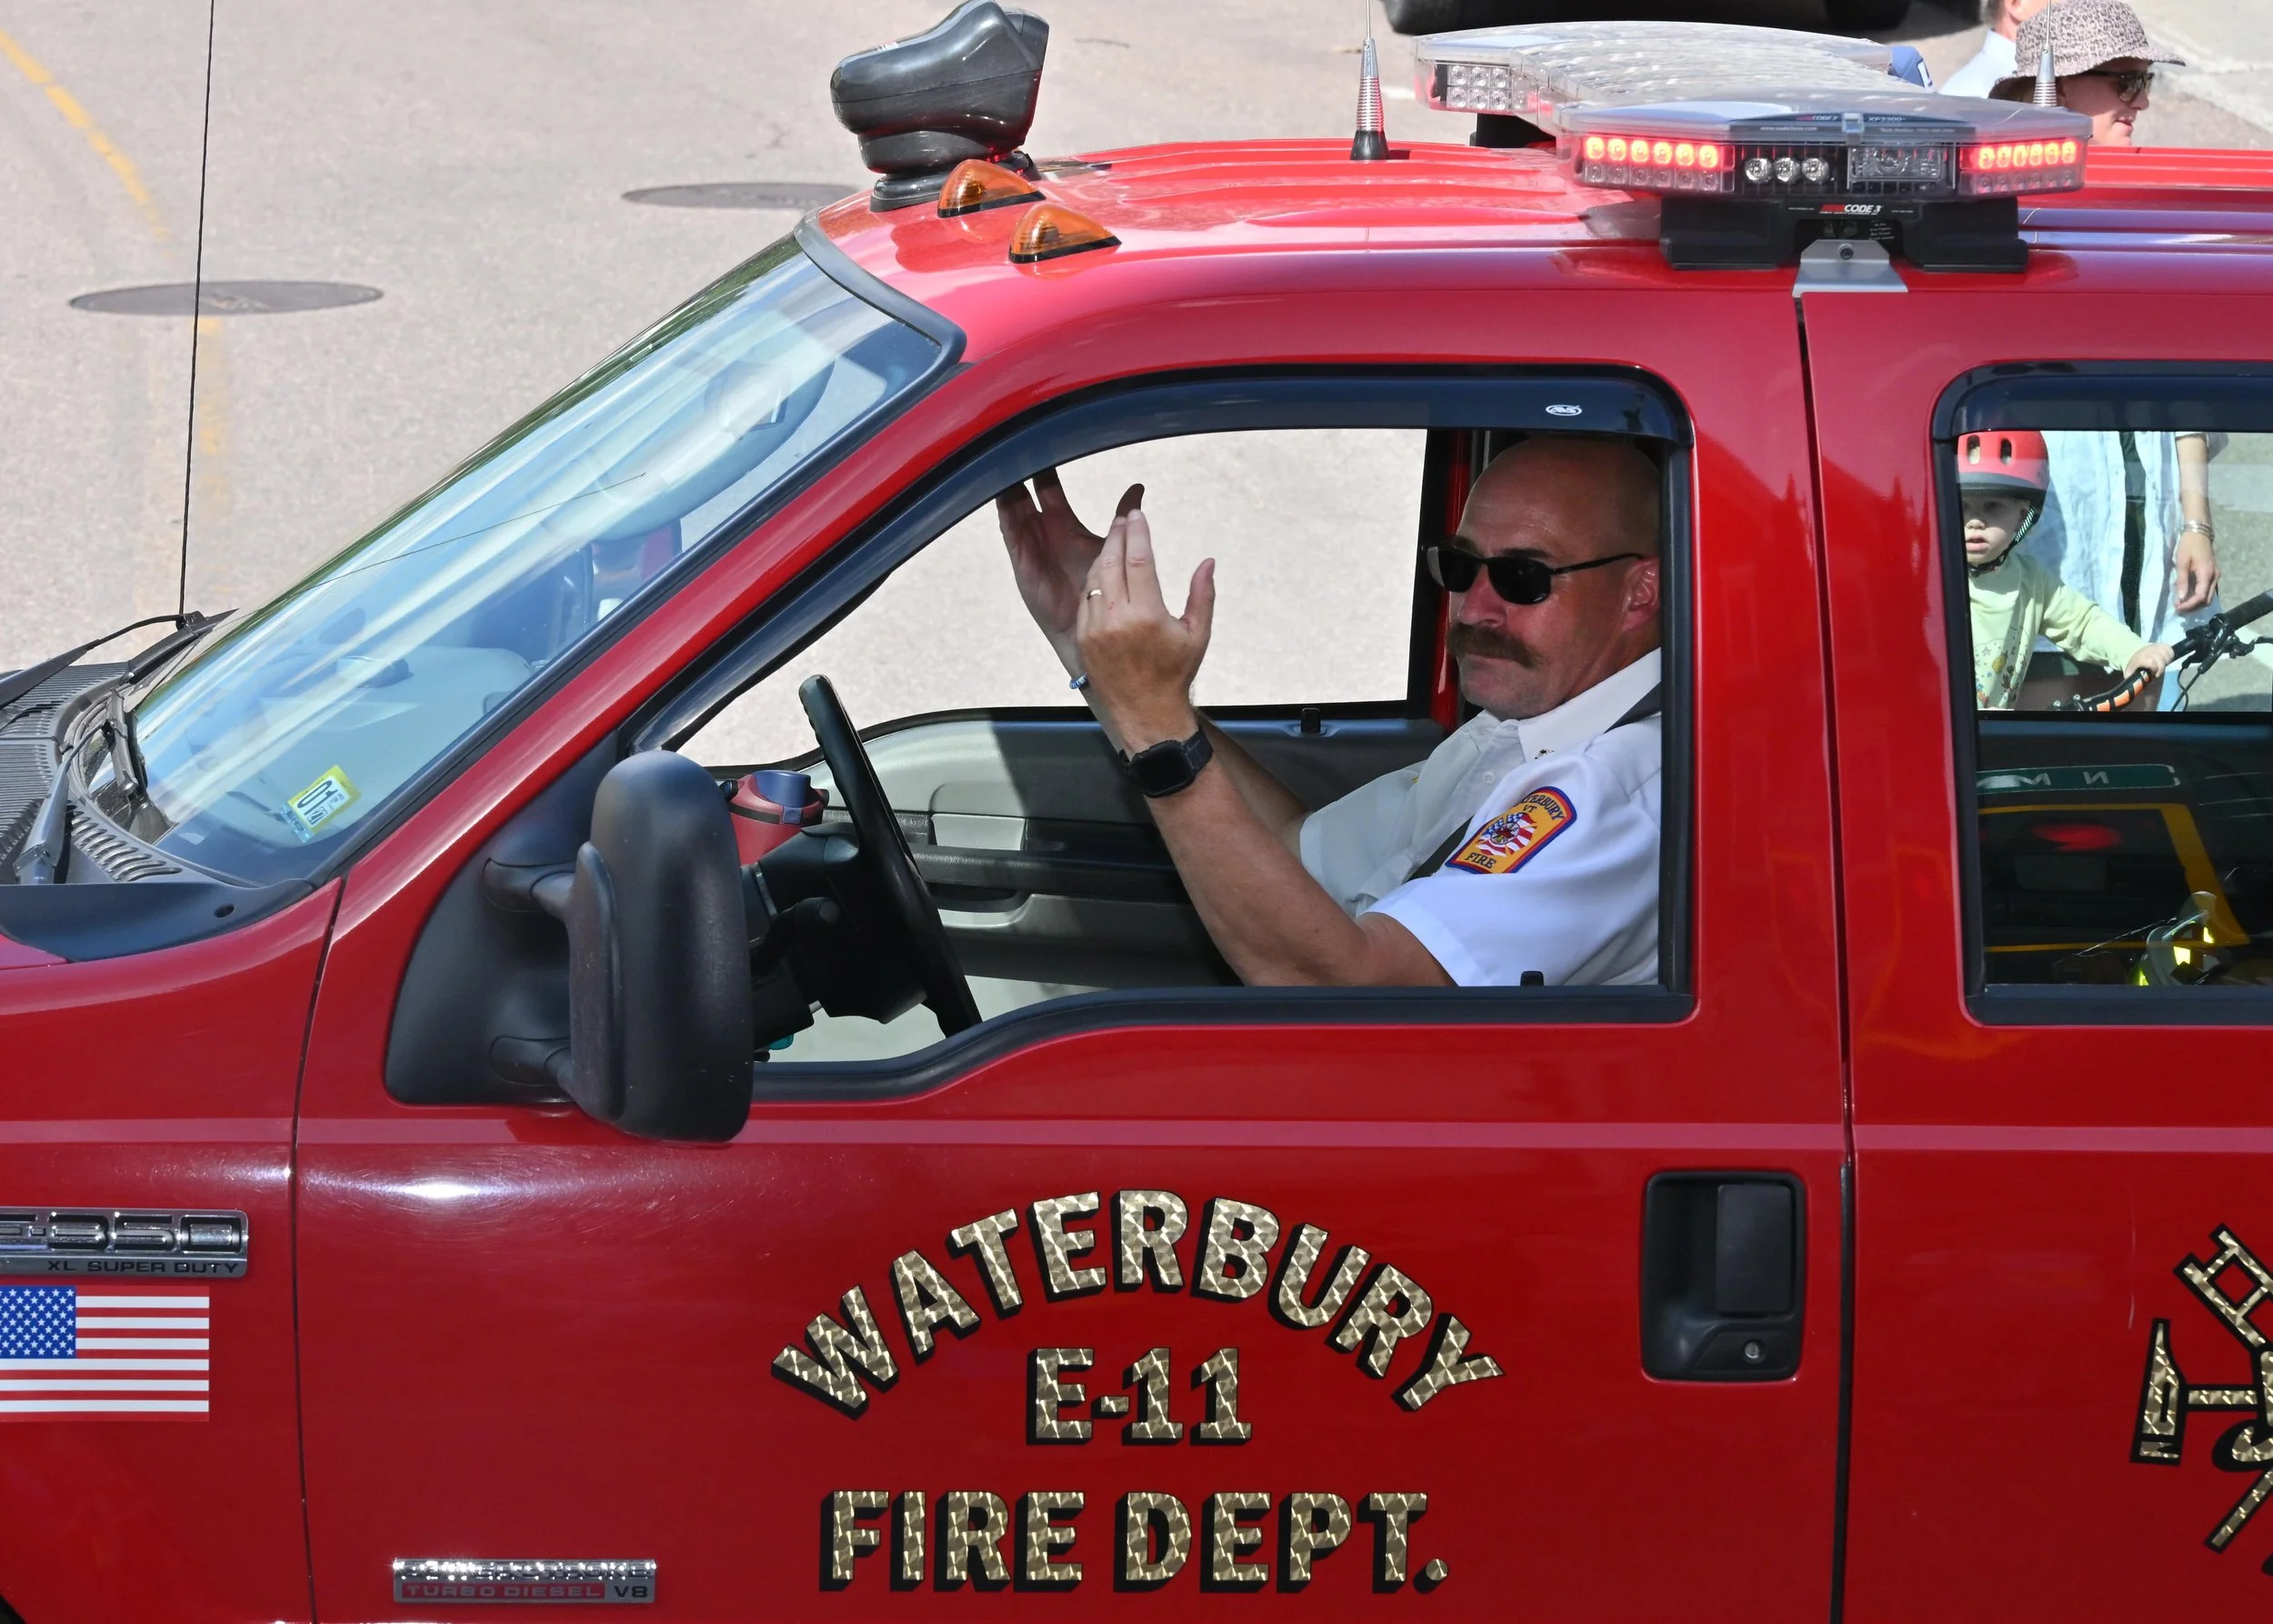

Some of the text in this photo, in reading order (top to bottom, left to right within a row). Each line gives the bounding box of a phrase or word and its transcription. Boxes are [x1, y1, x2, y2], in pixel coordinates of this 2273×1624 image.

[1844, 204, 1873, 214] CODE
[1873, 205, 1882, 214] 3
[1523, 804, 1537, 813] VT
[1465, 852, 1497, 869] FIRE
[48, 1260, 238, 1273] XL SUPER DUTY
[771, 1189, 1506, 1421] WATERBURY
[1026, 1348, 1253, 1446] E-11
[819, 1491, 1449, 1593] FIRE DEPT.
[406, 1585, 648, 1599] TURBO DIESEL V8
